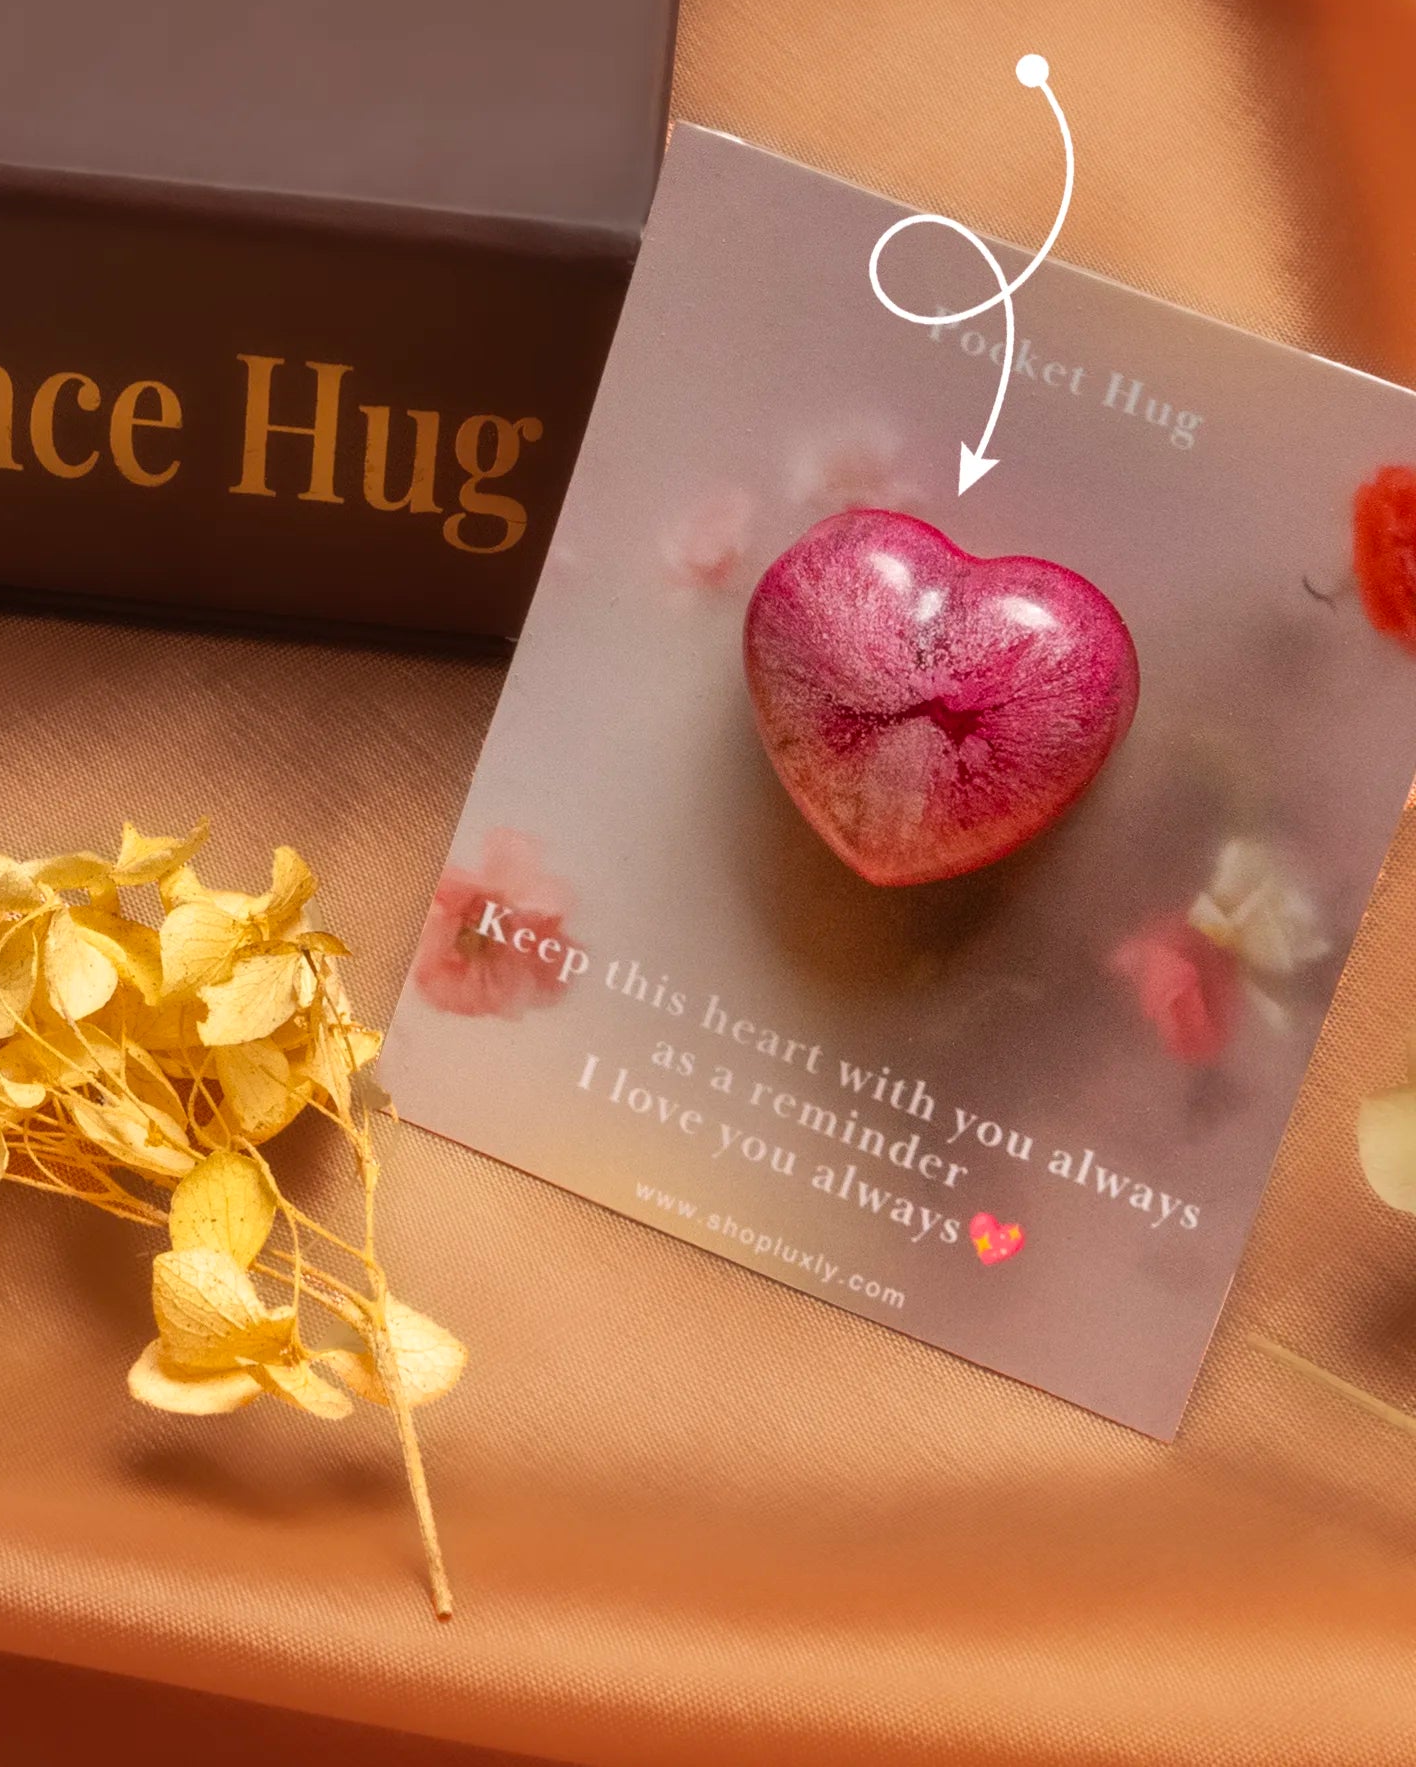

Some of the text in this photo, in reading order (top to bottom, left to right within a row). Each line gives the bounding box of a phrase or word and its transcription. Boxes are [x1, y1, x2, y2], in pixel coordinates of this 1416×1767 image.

[227, 351, 544, 555] Hug
[1101, 370, 1205, 451] Hug
[476, 899, 1201, 1230] Keep this heart with you always
[576, 1052, 962, 1244] I love you always
[651, 1040, 969, 1189] as a reminder
[635, 1180, 907, 1310] www.shopluxly.com
